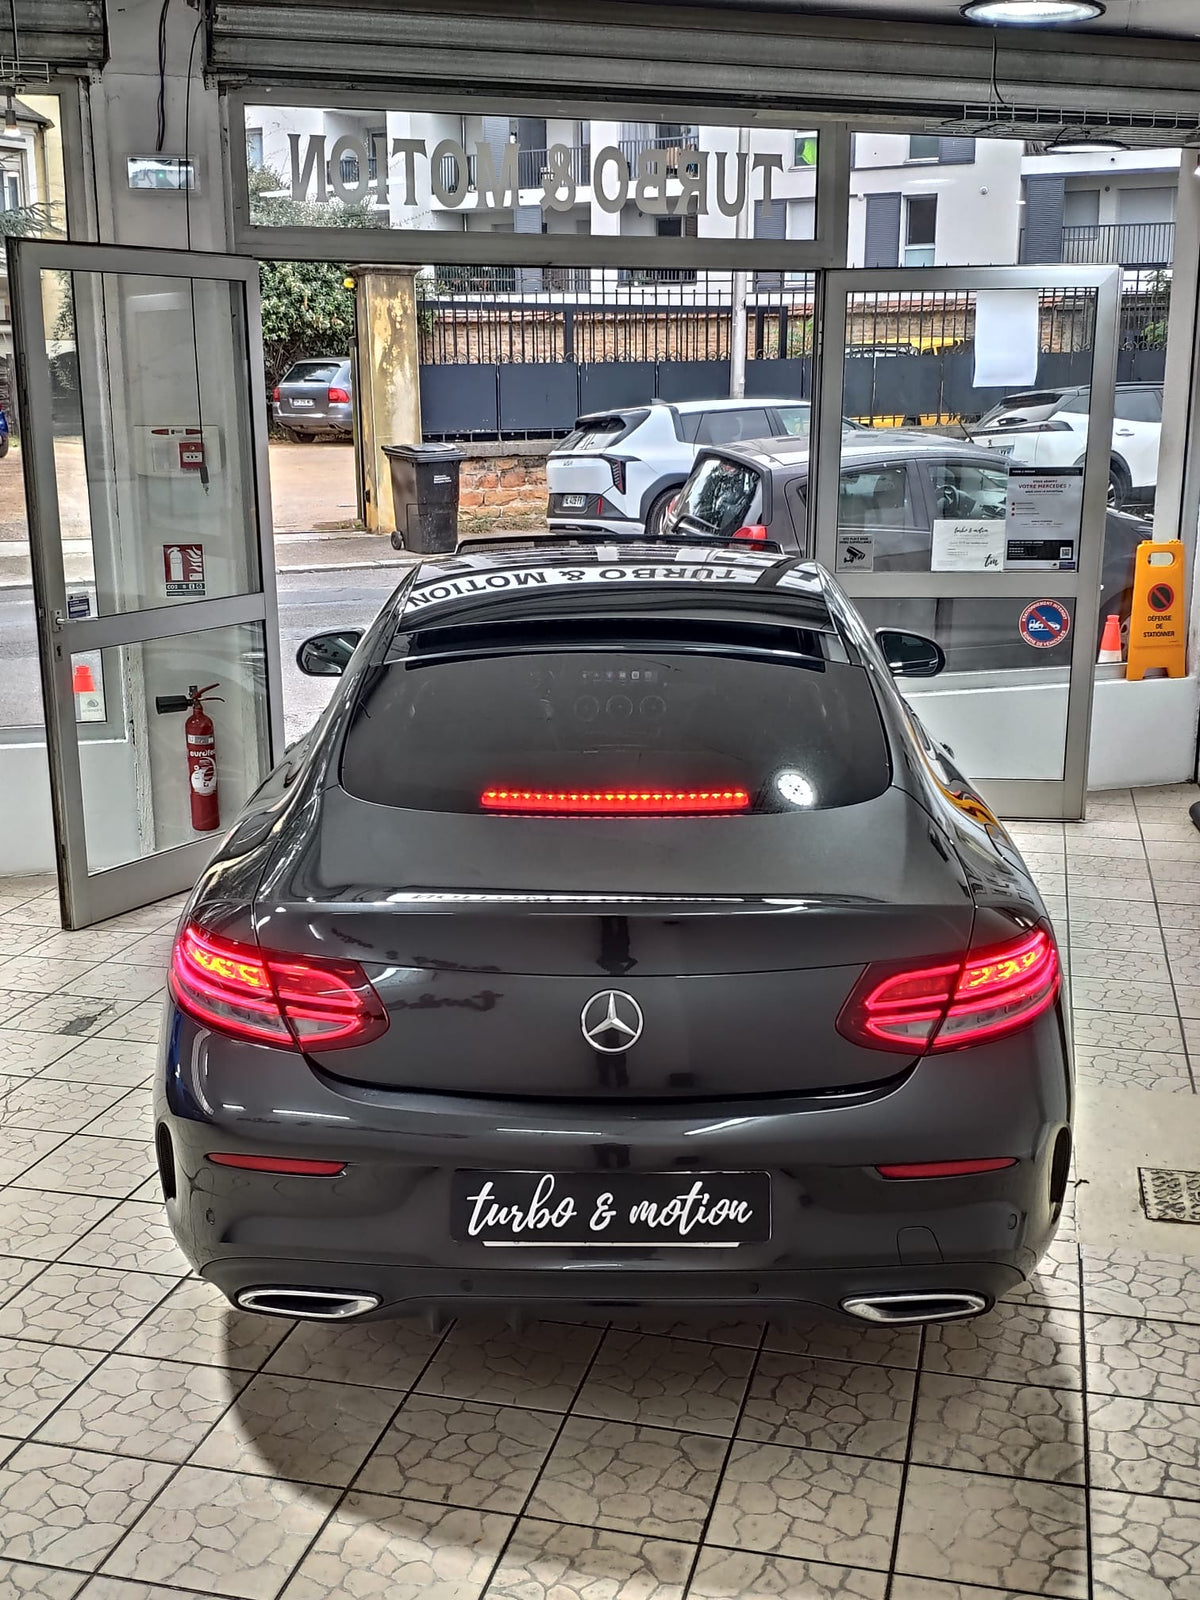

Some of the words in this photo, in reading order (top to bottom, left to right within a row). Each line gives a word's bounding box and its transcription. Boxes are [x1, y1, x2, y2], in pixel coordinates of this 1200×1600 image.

[1143, 630, 1175, 638] STATIONNER
[466, 1173, 578, 1237] turbo
[589, 1192, 617, 1231] &
[629, 1180, 753, 1236] motion
